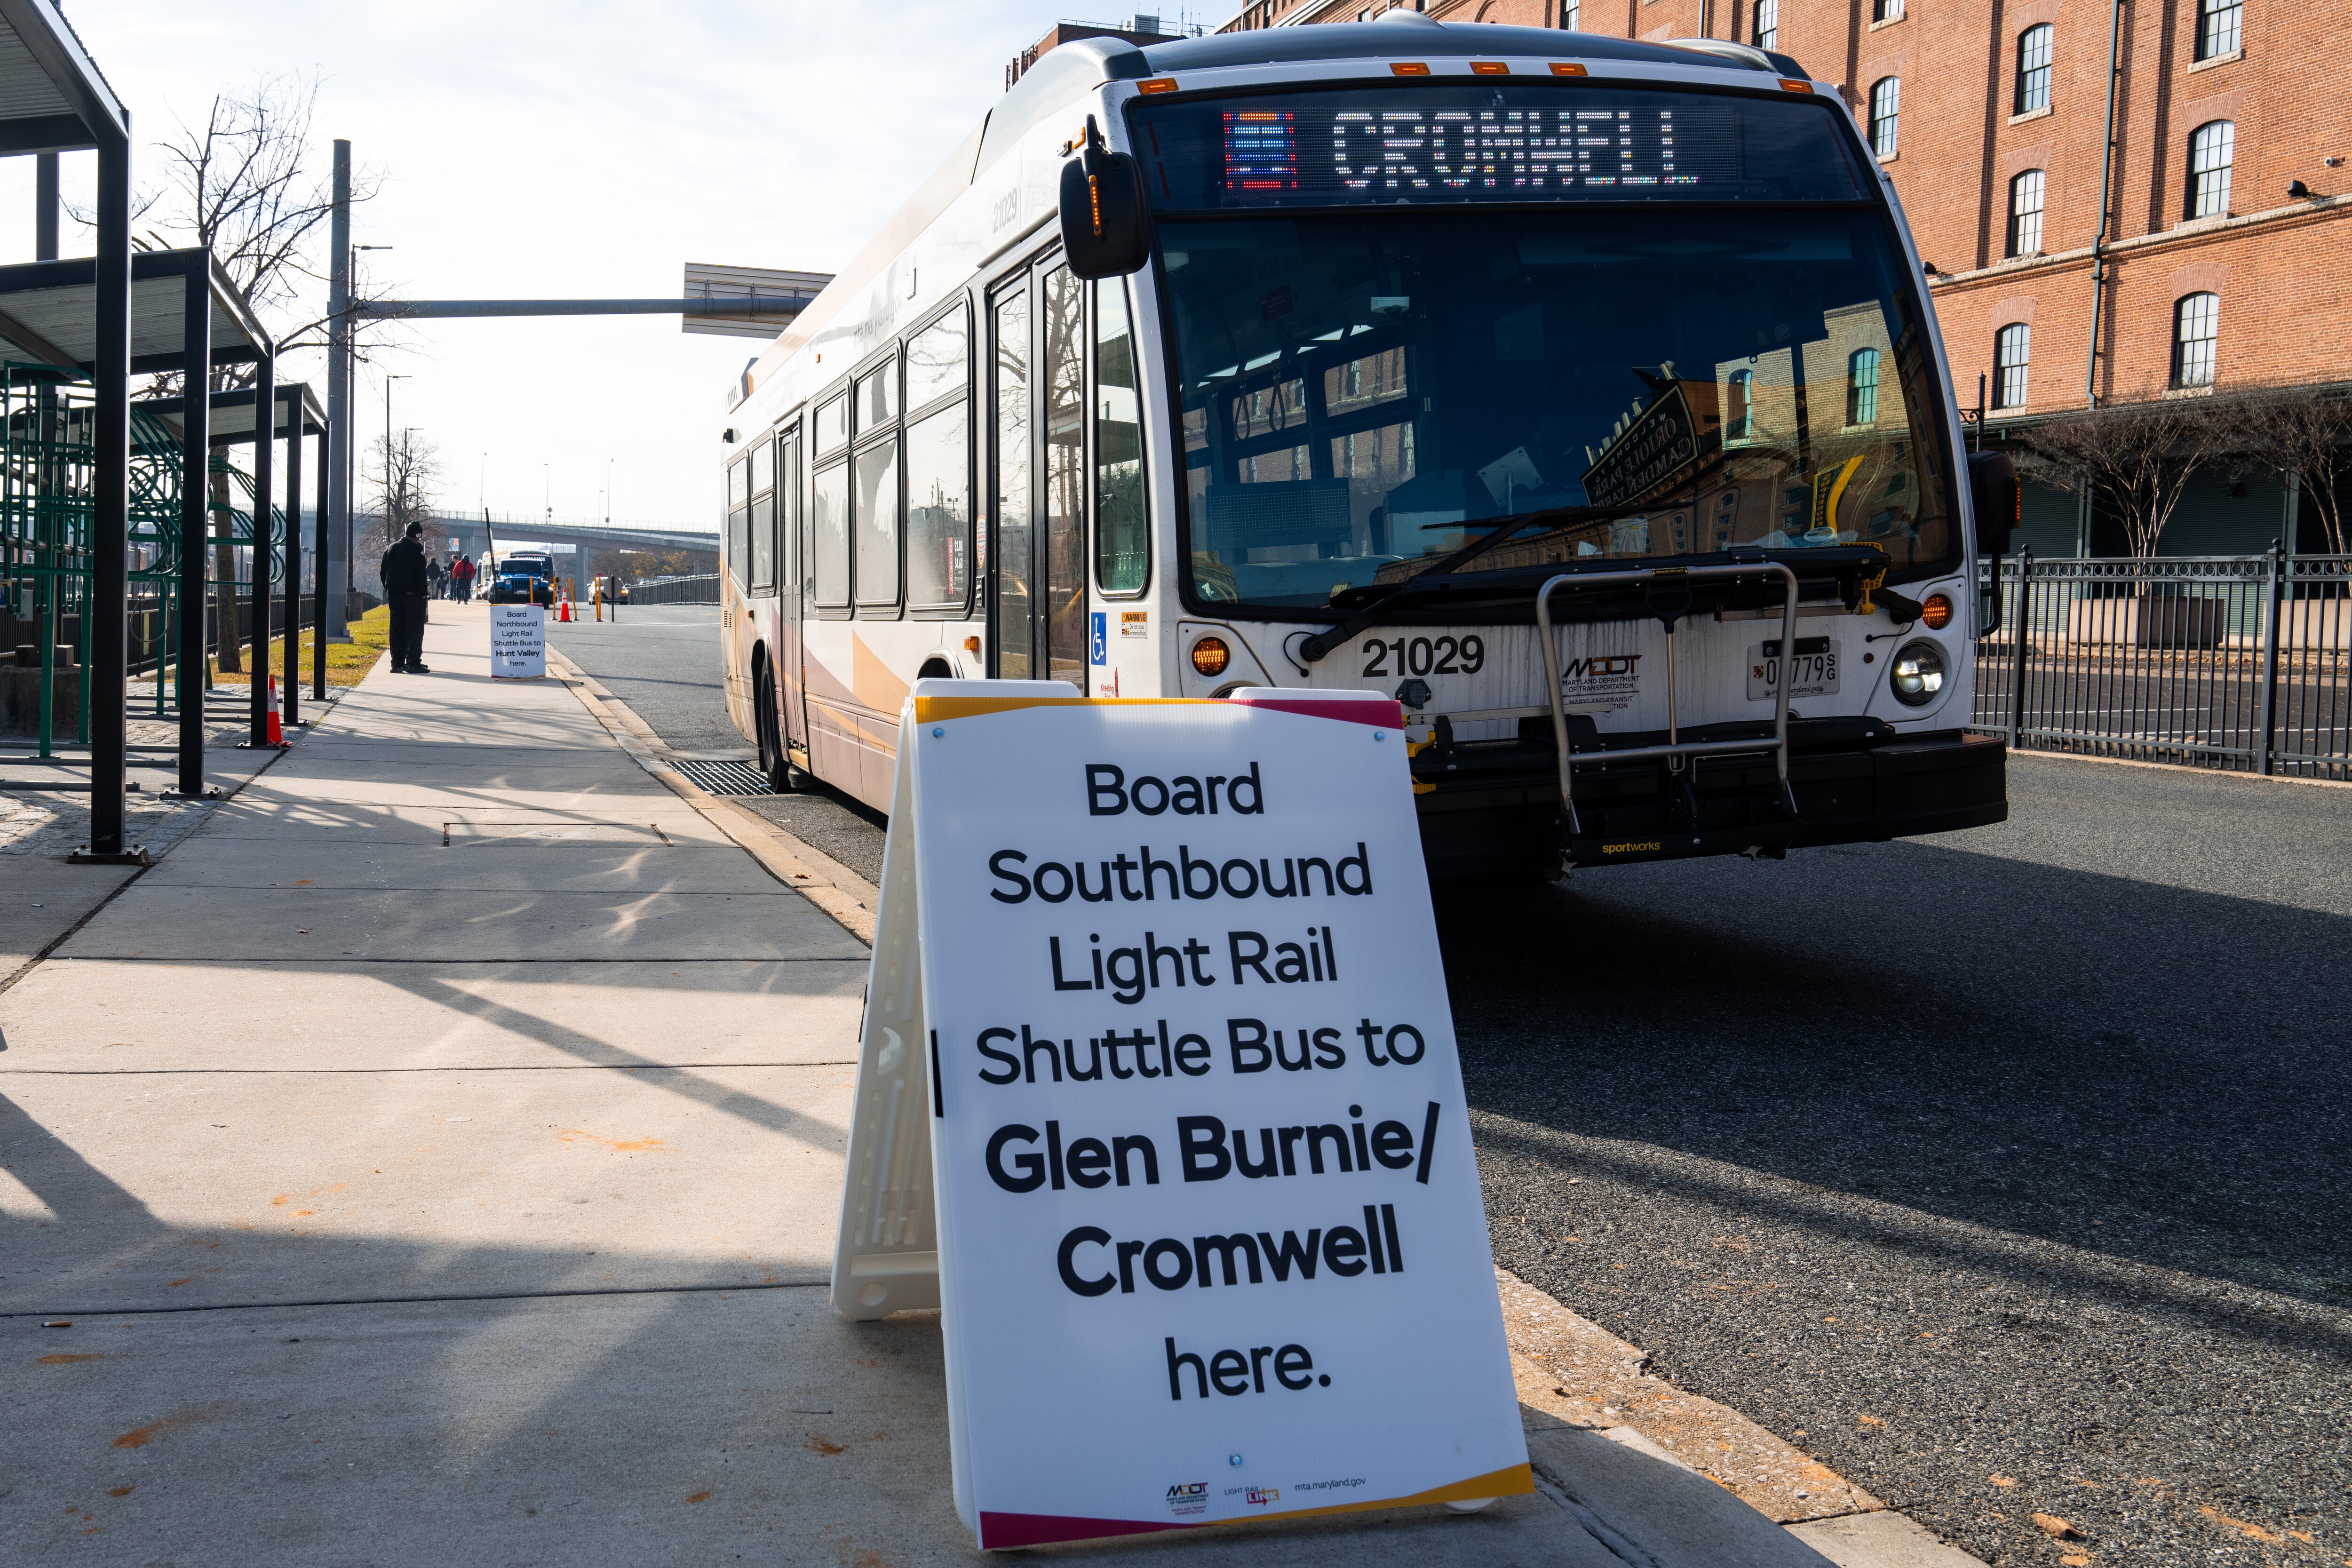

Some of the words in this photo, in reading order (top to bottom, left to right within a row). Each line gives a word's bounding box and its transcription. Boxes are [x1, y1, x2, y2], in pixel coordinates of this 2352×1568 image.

[1333, 112, 1698, 187] CROMWELL
[993, 187, 1017, 234] 21029
[1363, 635, 1484, 677] 21029
[1563, 654, 1643, 677] MDOT
[1767, 656, 1824, 685] 0779
[1101, 684, 1114, 694] Kneeling
[1579, 683, 1633, 691] TRANSPORTATION
[1085, 761, 1264, 816] Board
[1603, 841, 1660, 854] sportworks
[988, 842, 1373, 904] Southbound
[1049, 931, 1216, 1005] Light
[1228, 926, 1338, 985] Rail
[977, 1019, 1211, 1085] Shuttle
[1227, 1018, 1346, 1074] Bus
[1356, 1018, 1425, 1067] to
[985, 1120, 1160, 1194] Glen
[1176, 1100, 1441, 1185] Burnie/
[1057, 1203, 1404, 1297] Cromwell
[1165, 1337, 1331, 1401] here.
[1166, 1482, 1208, 1496] MDOT
[1224, 1487, 1243, 1495] LIGHT
[1247, 1489, 1278, 1502] LINK
[1295, 1478, 1366, 1491] mta.maryland.gov
